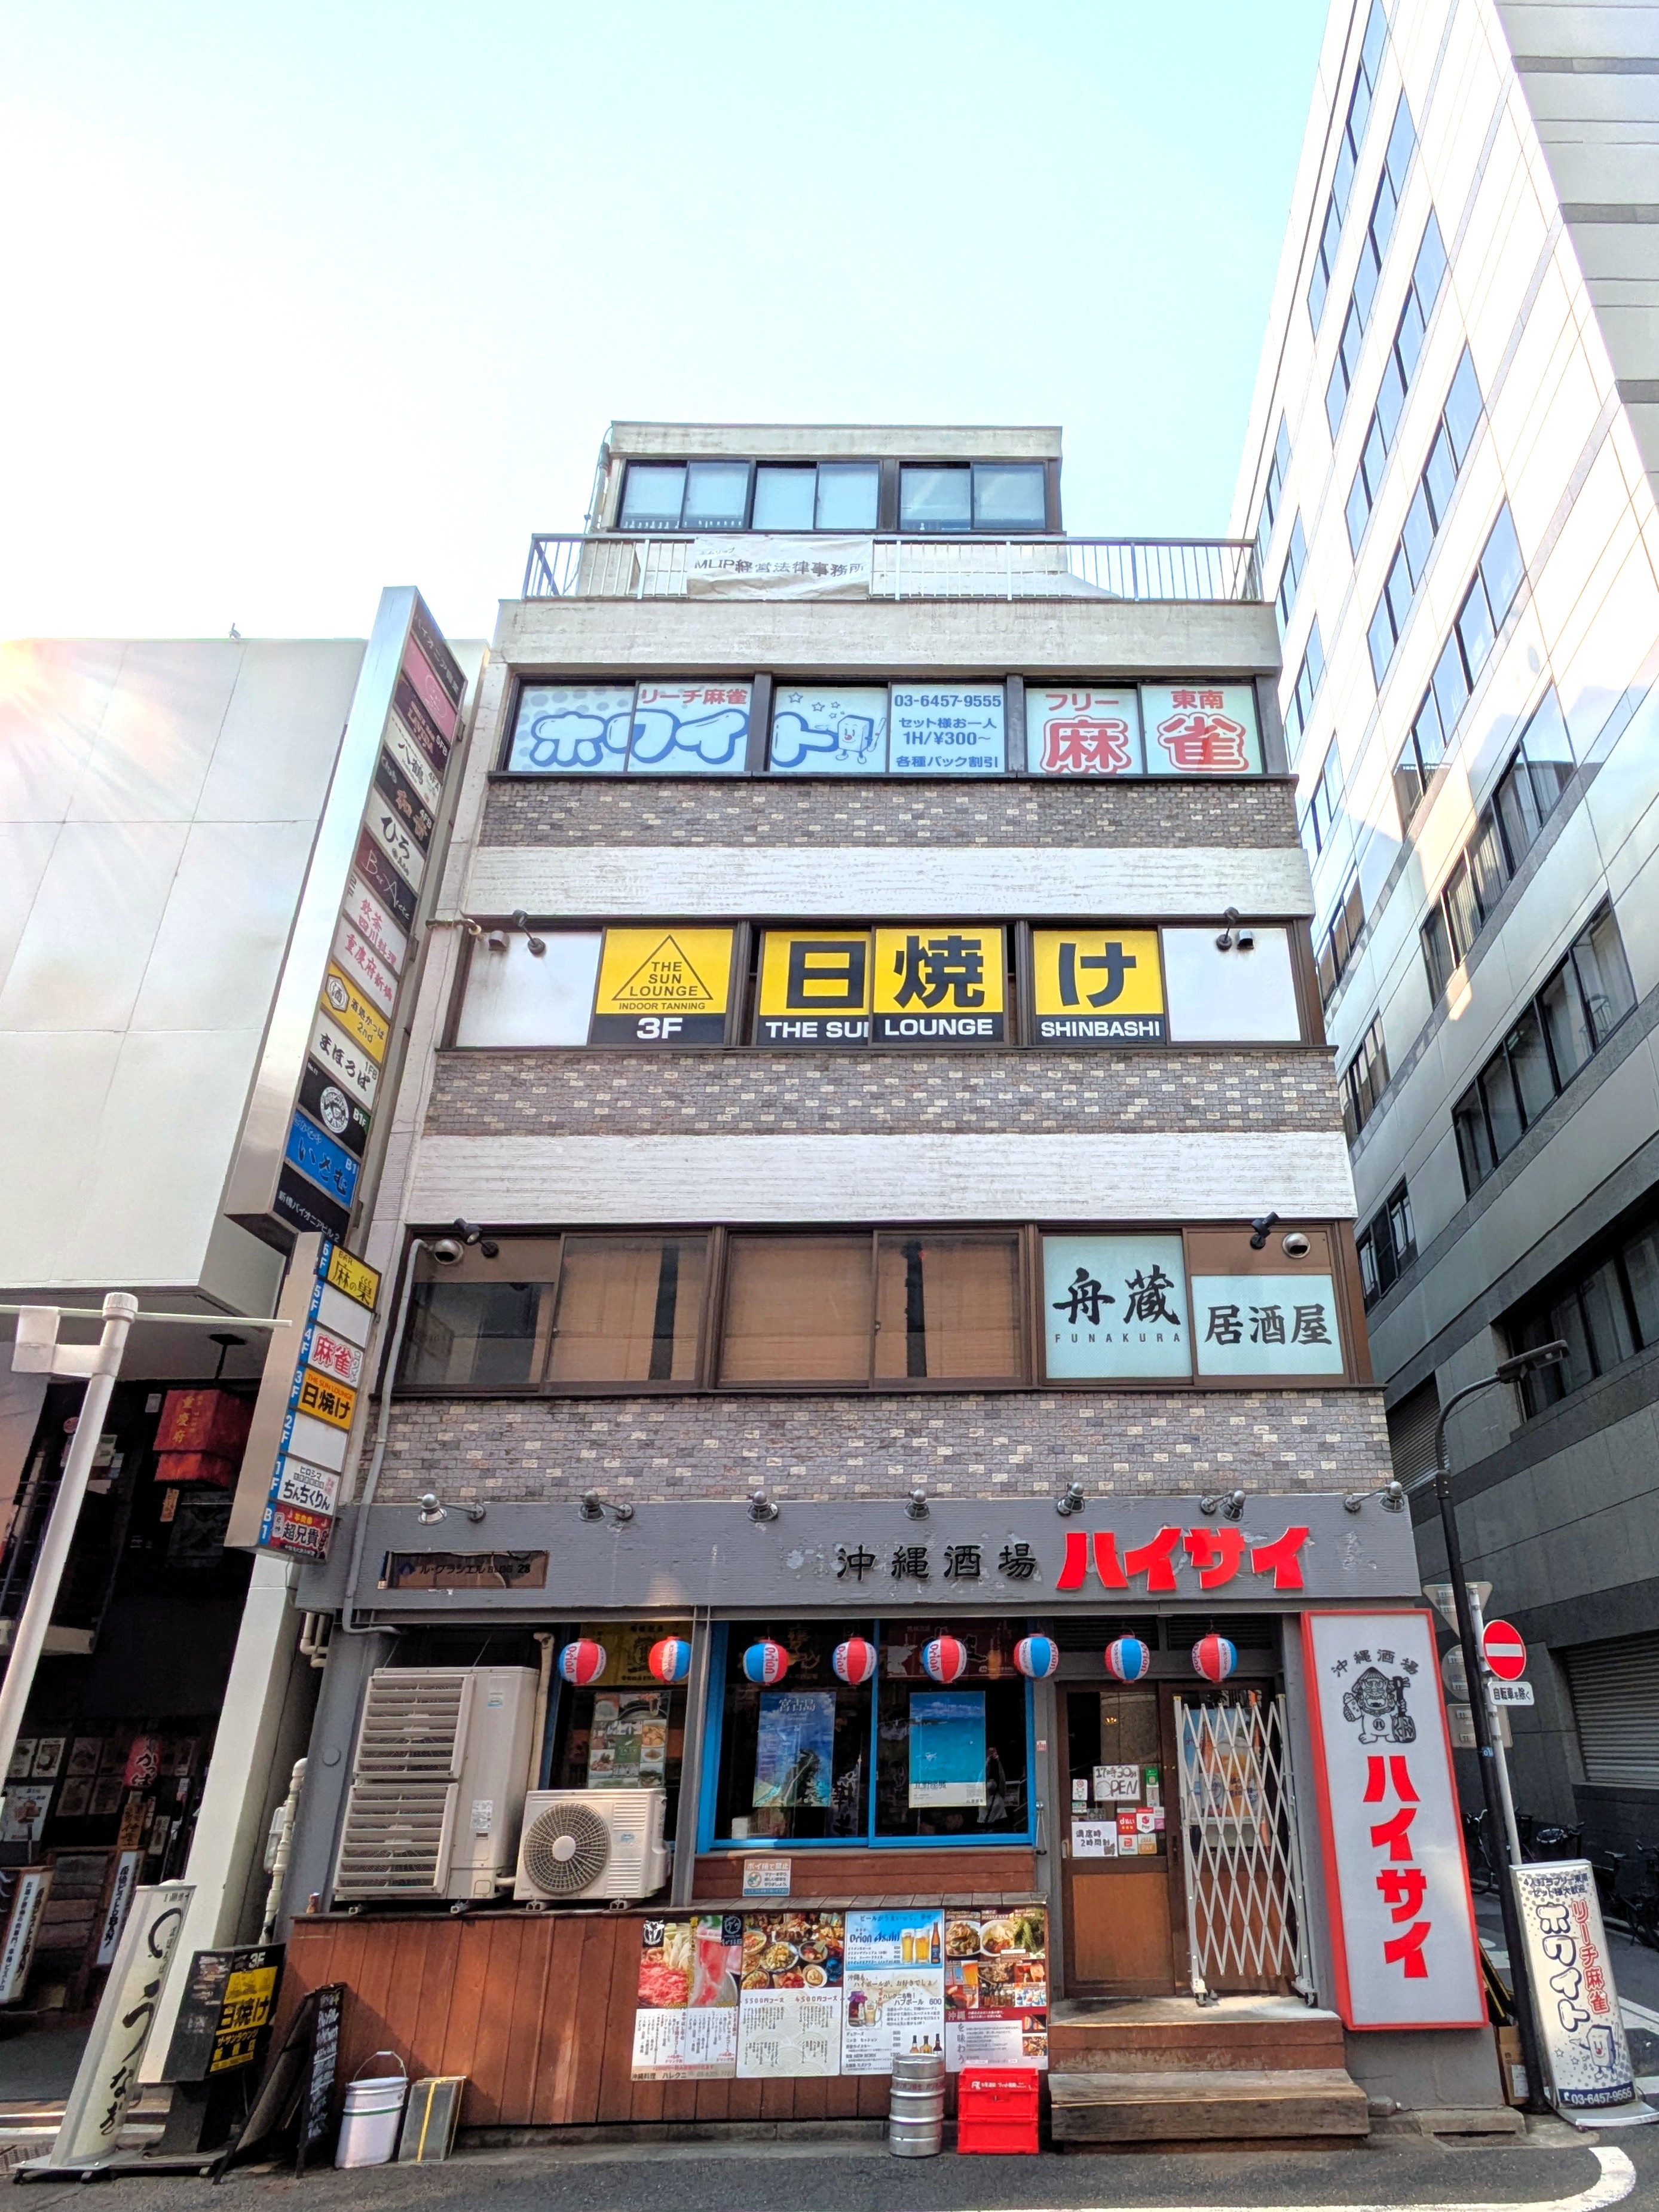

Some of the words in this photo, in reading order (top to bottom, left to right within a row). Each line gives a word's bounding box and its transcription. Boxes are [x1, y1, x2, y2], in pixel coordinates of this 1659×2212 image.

[694, 559, 865, 577] MLIP経営法律事務所
[641, 689, 748, 705] リーチ麻雀
[895, 694, 1002, 708] 03-6457-9555
[1046, 693, 1119, 711] フリー
[1171, 690, 1224, 709] 東南
[899, 718, 997, 729] セット様お一人
[530, 709, 837, 767] ホワイト
[896, 755, 999, 769] 各種パック割引
[380, 816, 409, 859] ひろ
[359, 914, 397, 966] 四川料理
[345, 933, 393, 1002] 重慶府新橋
[648, 973, 682, 984] SUN
[651, 962, 682, 972] THE
[786, 934, 1136, 1009] 日焼け
[629, 986, 698, 997] LOUNGE
[357, 1022, 374, 1044] 2nd
[636, 1017, 683, 1039] 3F
[766, 1021, 818, 1038] THE
[826, 1021, 869, 1038] SU
[884, 1018, 993, 1036] LOUNGE
[1040, 1020, 1161, 1037] SHINBASHI
[353, 1107, 367, 1127] B1F
[338, 1250, 354, 1266] BAR
[332, 1259, 372, 1307] 麻の巣
[1052, 1264, 1181, 1326] 舟蔵
[310, 1284, 321, 1312] 5F
[1055, 1333, 1181, 1343] FUNAKURA
[1204, 1303, 1333, 1346] 居酒屋
[301, 1328, 312, 1356] 4F
[312, 1333, 354, 1379] 麻雀
[290, 1367, 303, 1402] 3F
[307, 1373, 319, 1384] THE
[318, 1378, 332, 1391] SUN
[330, 1384, 354, 1402] LOUNGE
[301, 1380, 351, 1421] 日焼け
[280, 1413, 293, 1446] 2F
[271, 1461, 281, 1491] 1F
[299, 1465, 322, 1481] ヒロシマ
[283, 1479, 330, 1512] ちんちくりん
[262, 1507, 273, 1539] B1
[281, 1522, 319, 1547] 超兄貴
[518, 1564, 531, 1574] 28
[836, 1543, 1037, 1581] 沖縄酒場
[1056, 1526, 1310, 1592] ハイサイ
[565, 1645, 577, 1674] Orion
[765, 1647, 779, 1675] Orion
[837, 1645, 846, 1674] Orion
[929, 1644, 939, 1672] Orion
[1330, 1648, 1419, 1678] 沖縄酒場
[1493, 1687, 1531, 1701] 自転車を除く
[1095, 1780, 1138, 1798] OPEN
[1363, 1755, 1431, 1978] ハイサイ
[1523, 1873, 1589, 1887] 4人打ちフリー東南
[849, 1932, 872, 1943] Orion
[249, 1951, 267, 1969] 3F
[1535, 1901, 1590, 2033] ホワイト
[1571, 1899, 1611, 2015] リーチ麻雀
[947, 2011, 966, 2021] 沖縄
[957, 2023, 966, 2064] を味わう
[1571, 2085, 1633, 2106] 03-6457-9555
